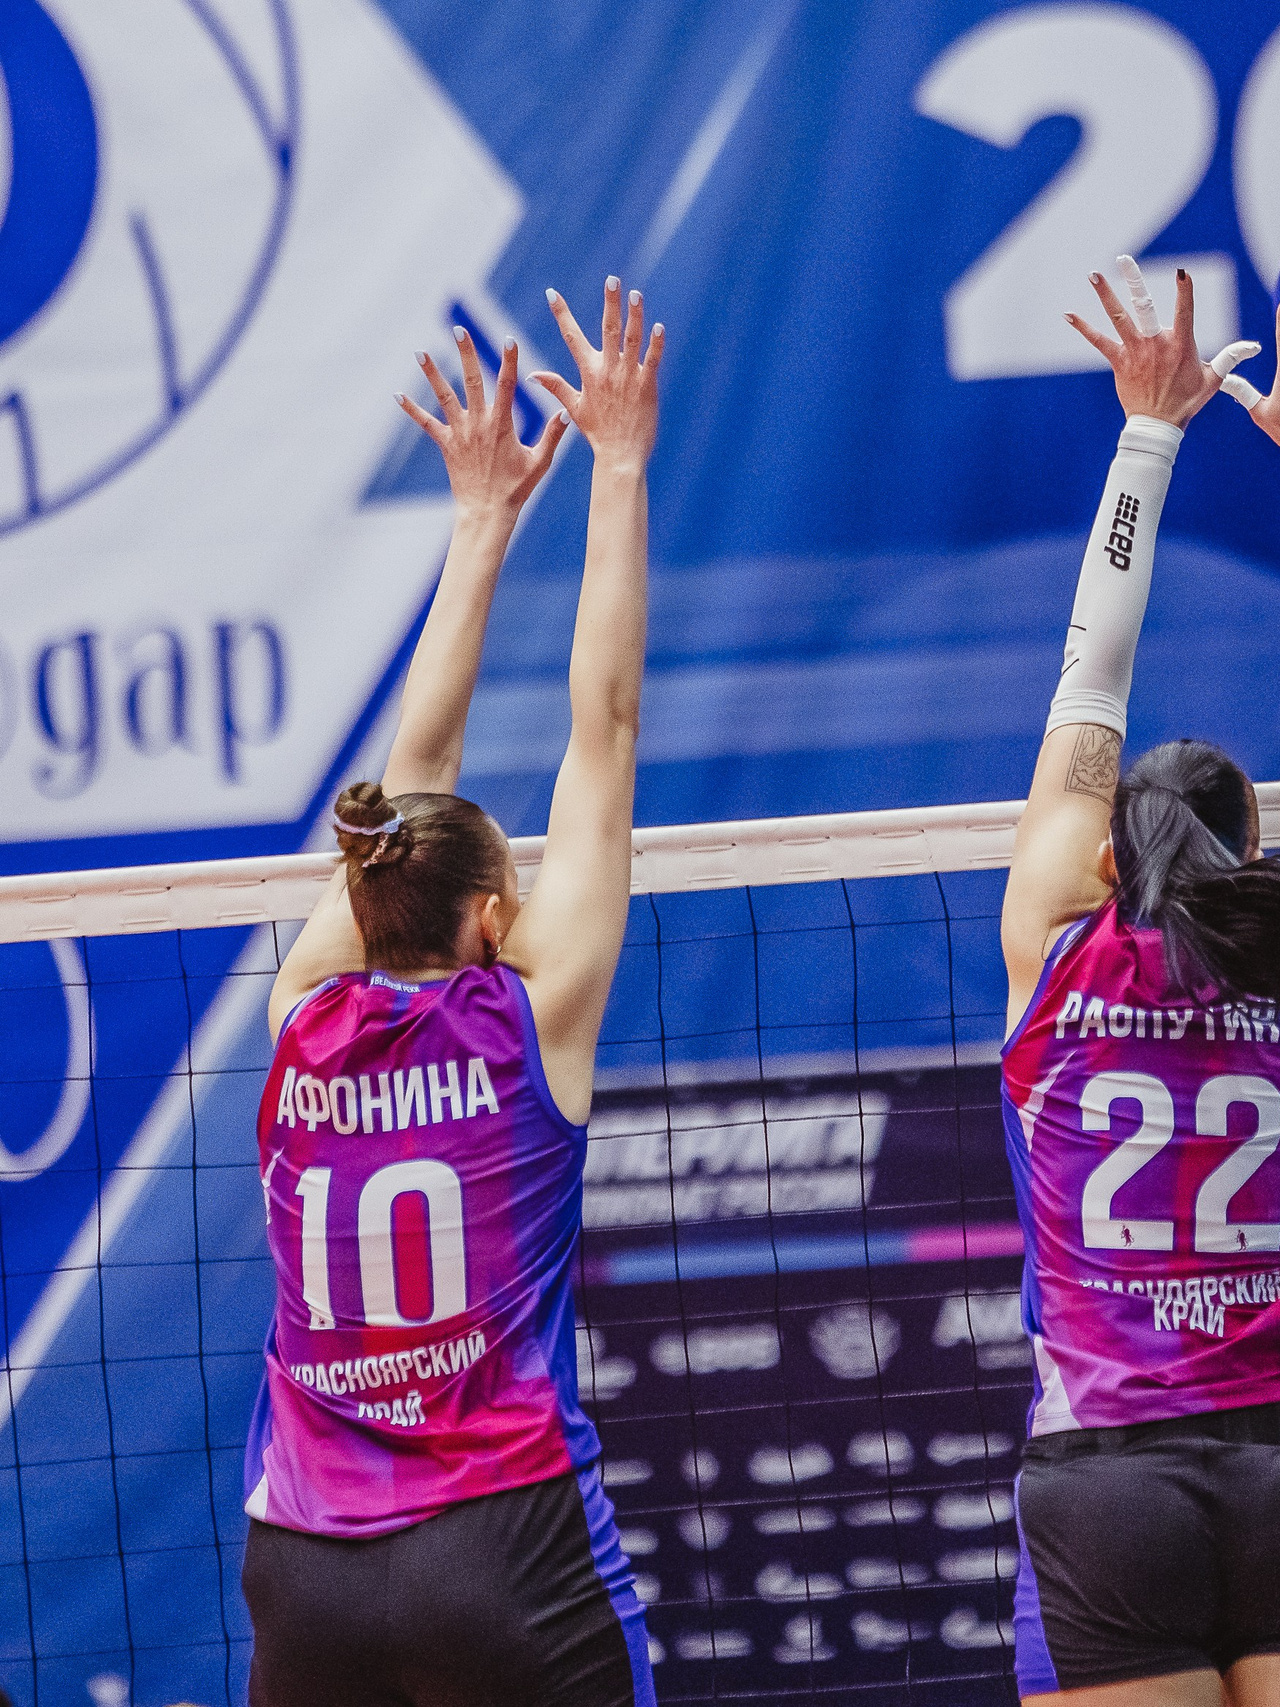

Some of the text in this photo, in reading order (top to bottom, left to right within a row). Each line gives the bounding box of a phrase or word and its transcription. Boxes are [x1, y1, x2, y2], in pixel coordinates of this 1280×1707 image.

[1103, 516, 1136, 572] cep
[276, 1056, 500, 1136] АФОНИНА
[294, 1158, 467, 1331] 10
